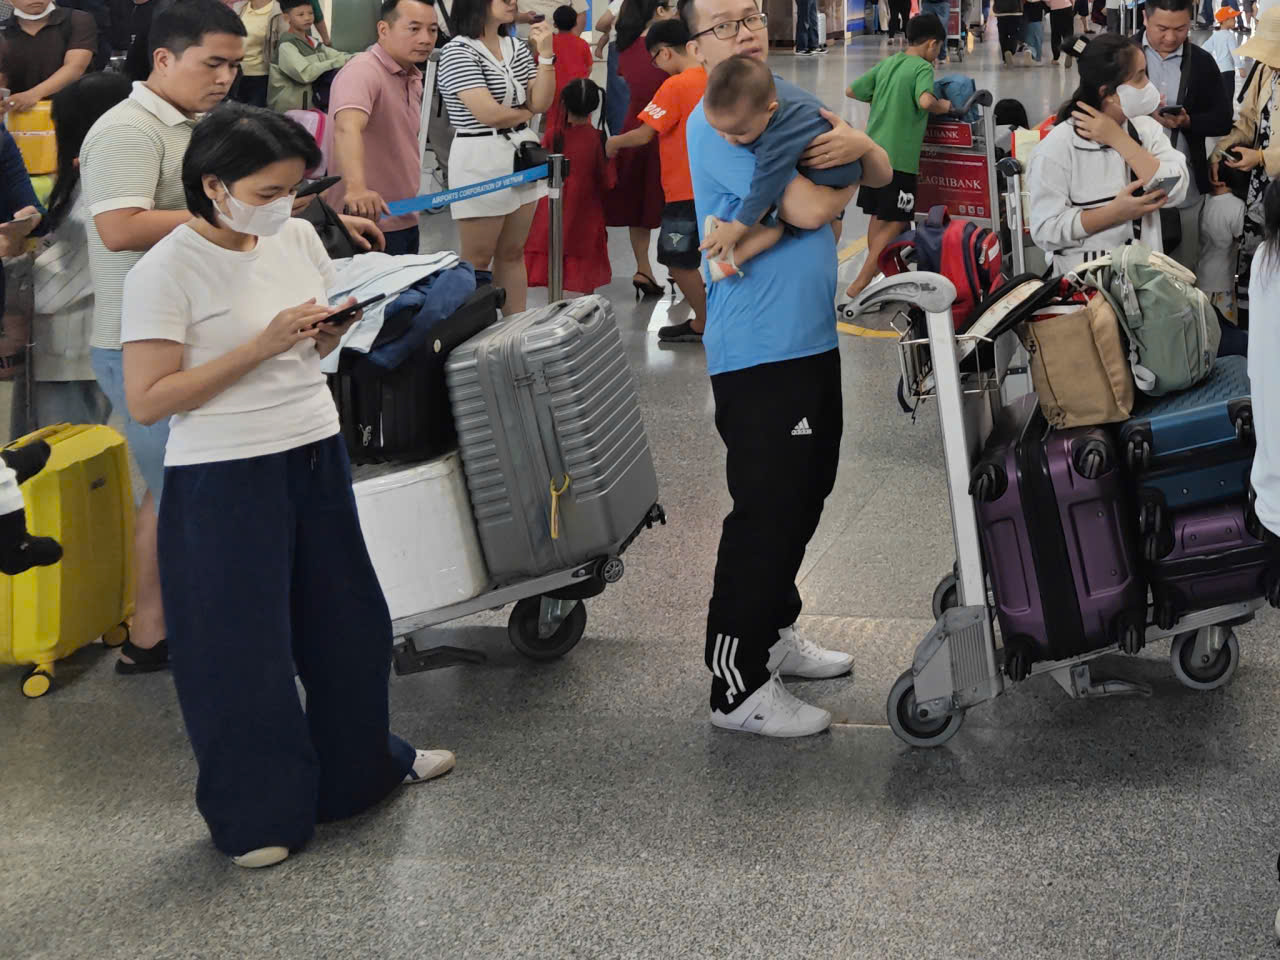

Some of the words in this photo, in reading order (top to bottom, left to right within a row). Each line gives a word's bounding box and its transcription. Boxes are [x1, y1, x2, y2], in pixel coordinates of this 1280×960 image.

[432, 191, 459, 204] AIRPORTS
[459, 183, 495, 198] CORPORATION
[495, 180, 502, 189] OF
[926, 175, 982, 190] AGRIBANK
